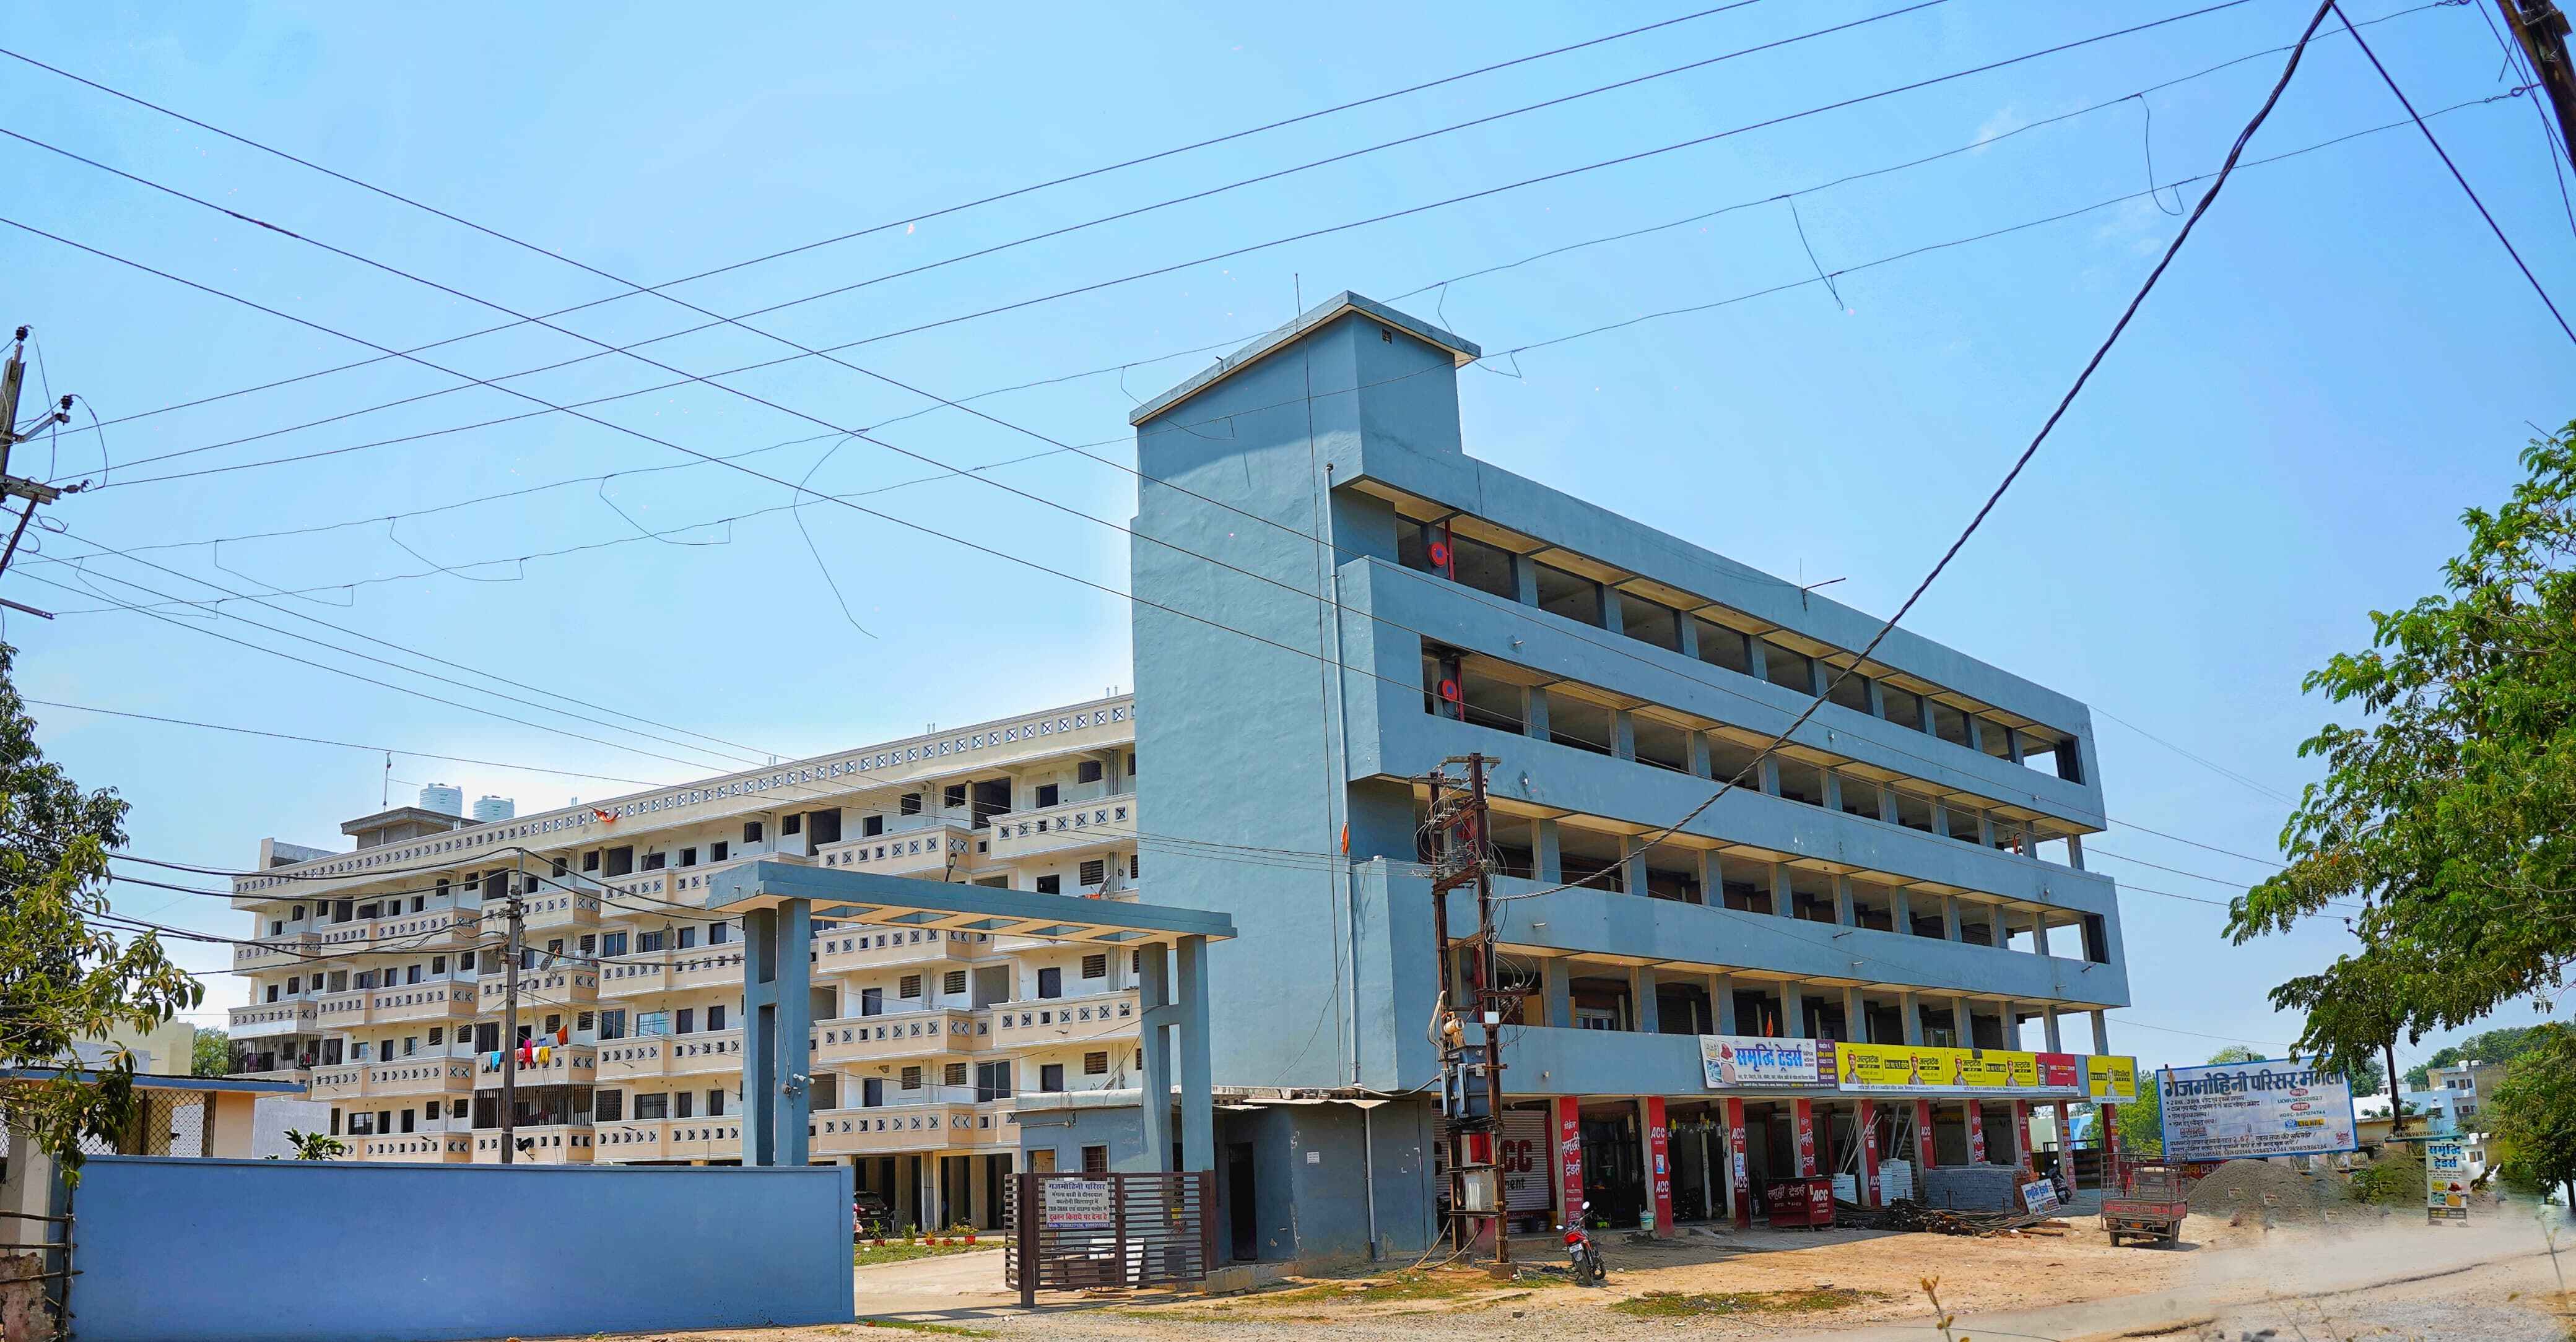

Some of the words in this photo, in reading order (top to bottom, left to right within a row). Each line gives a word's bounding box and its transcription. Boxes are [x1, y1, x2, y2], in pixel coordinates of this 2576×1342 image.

[1775, 1044, 1803, 1071] ट्रेडर्स
[2164, 1071, 2248, 1097] गजमोहिनी
[1651, 1127, 1665, 1138] ACC
[1732, 1128, 1744, 1139] ACC
[1921, 1126, 1931, 1136] ACC
[1565, 1160, 1581, 1176] ट्रेडर्स
[2432, 1156, 2458, 1170] ट्रेडर्स
[2201, 1164, 2222, 1175] CEM
[1506, 1177, 1525, 1189] ent
[1734, 1176, 1747, 1188] ACC
[1870, 1175, 1880, 1185] ACC
[1656, 1180, 1669, 1193] ACC
[1788, 1184, 1806, 1197] ट्रेडर्स
[1812, 1189, 1829, 1201] ACC
